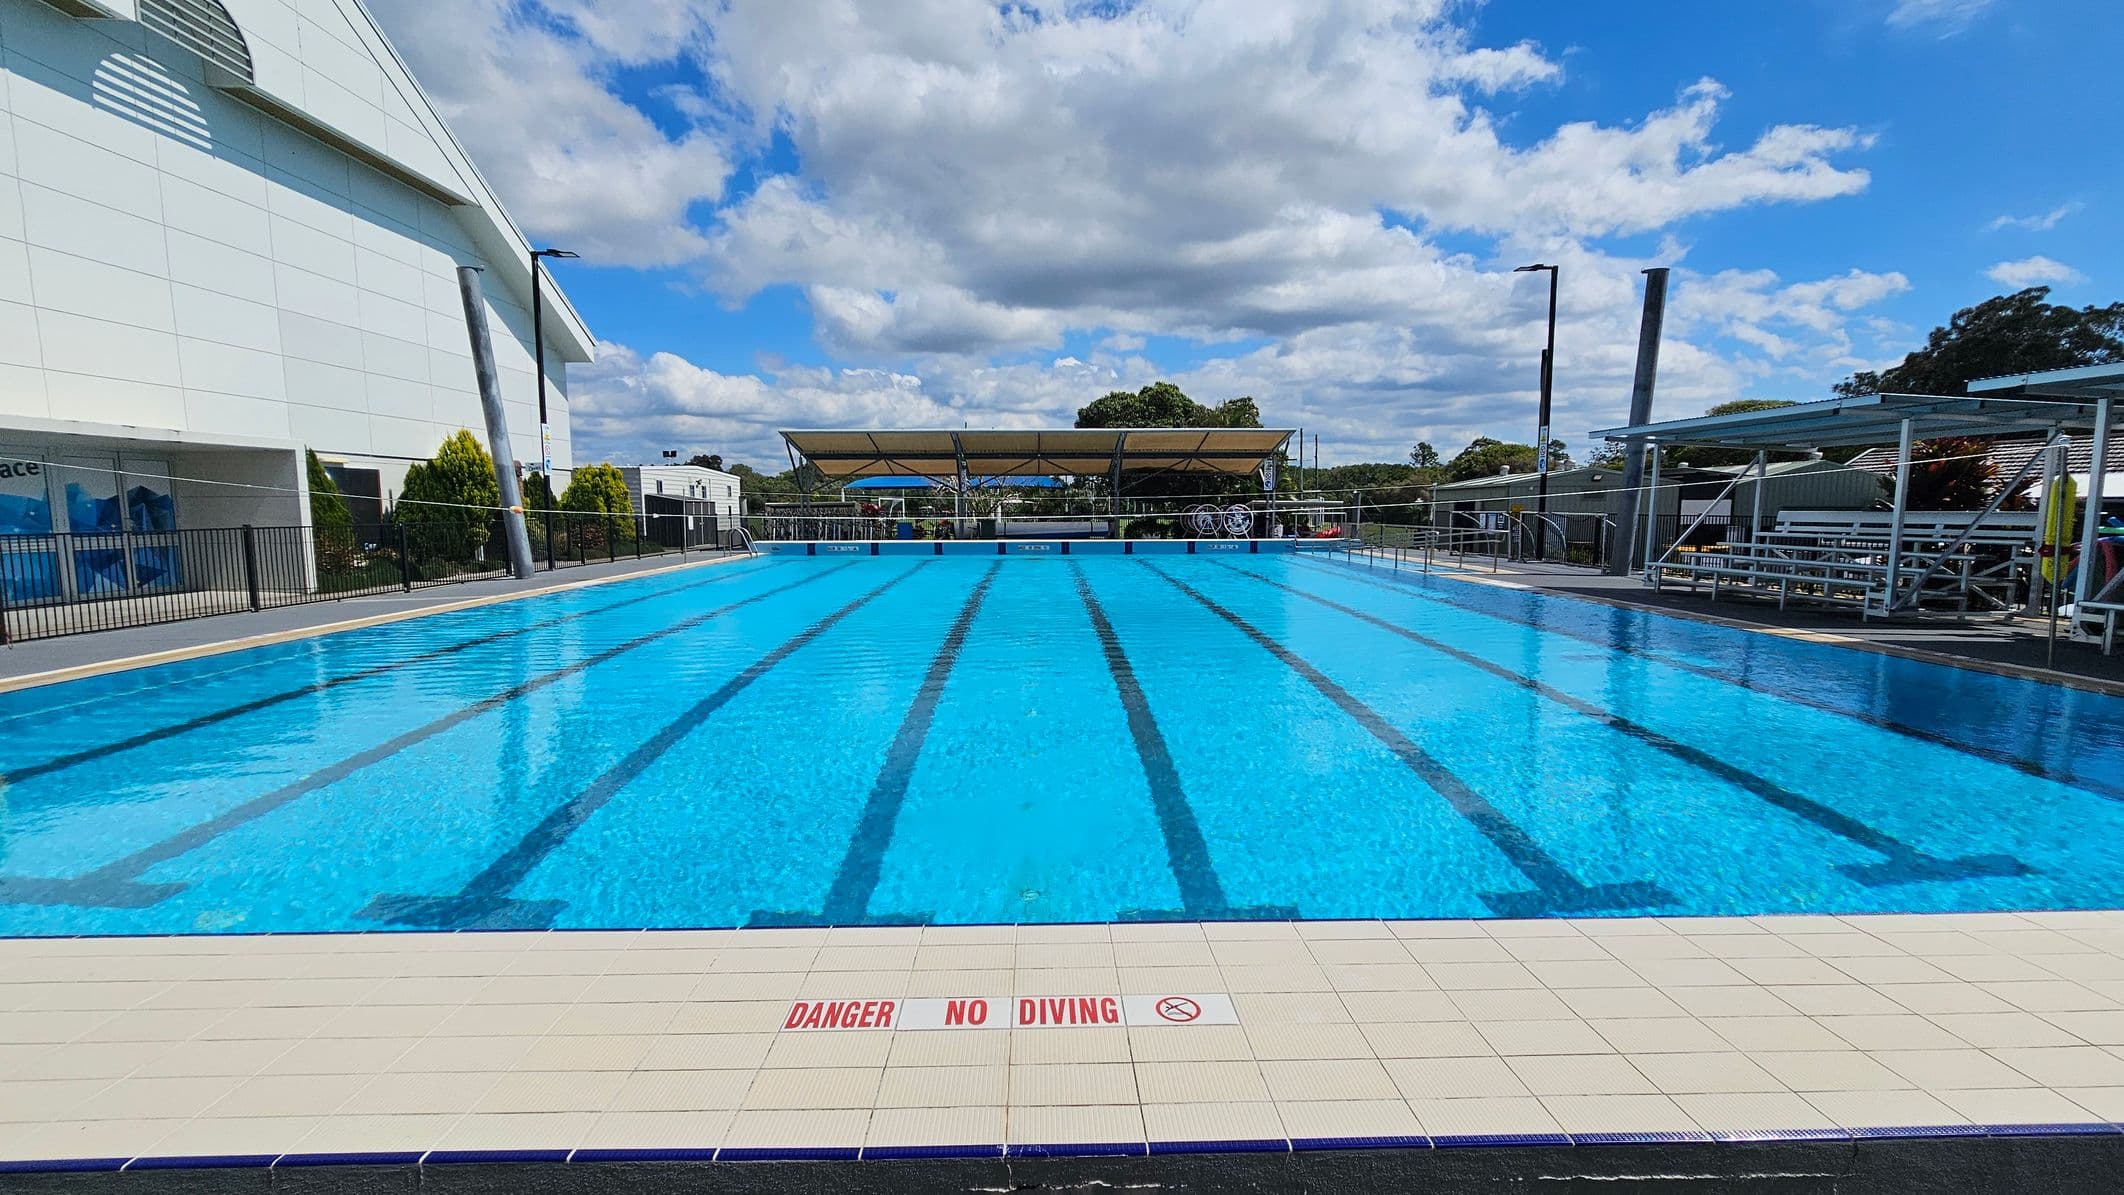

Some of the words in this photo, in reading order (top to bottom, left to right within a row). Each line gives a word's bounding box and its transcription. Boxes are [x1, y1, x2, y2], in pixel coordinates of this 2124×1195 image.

[786, 1001, 894, 1029] DANGER
[945, 999, 988, 1025] NO
[1019, 997, 1119, 1025] DIVING
